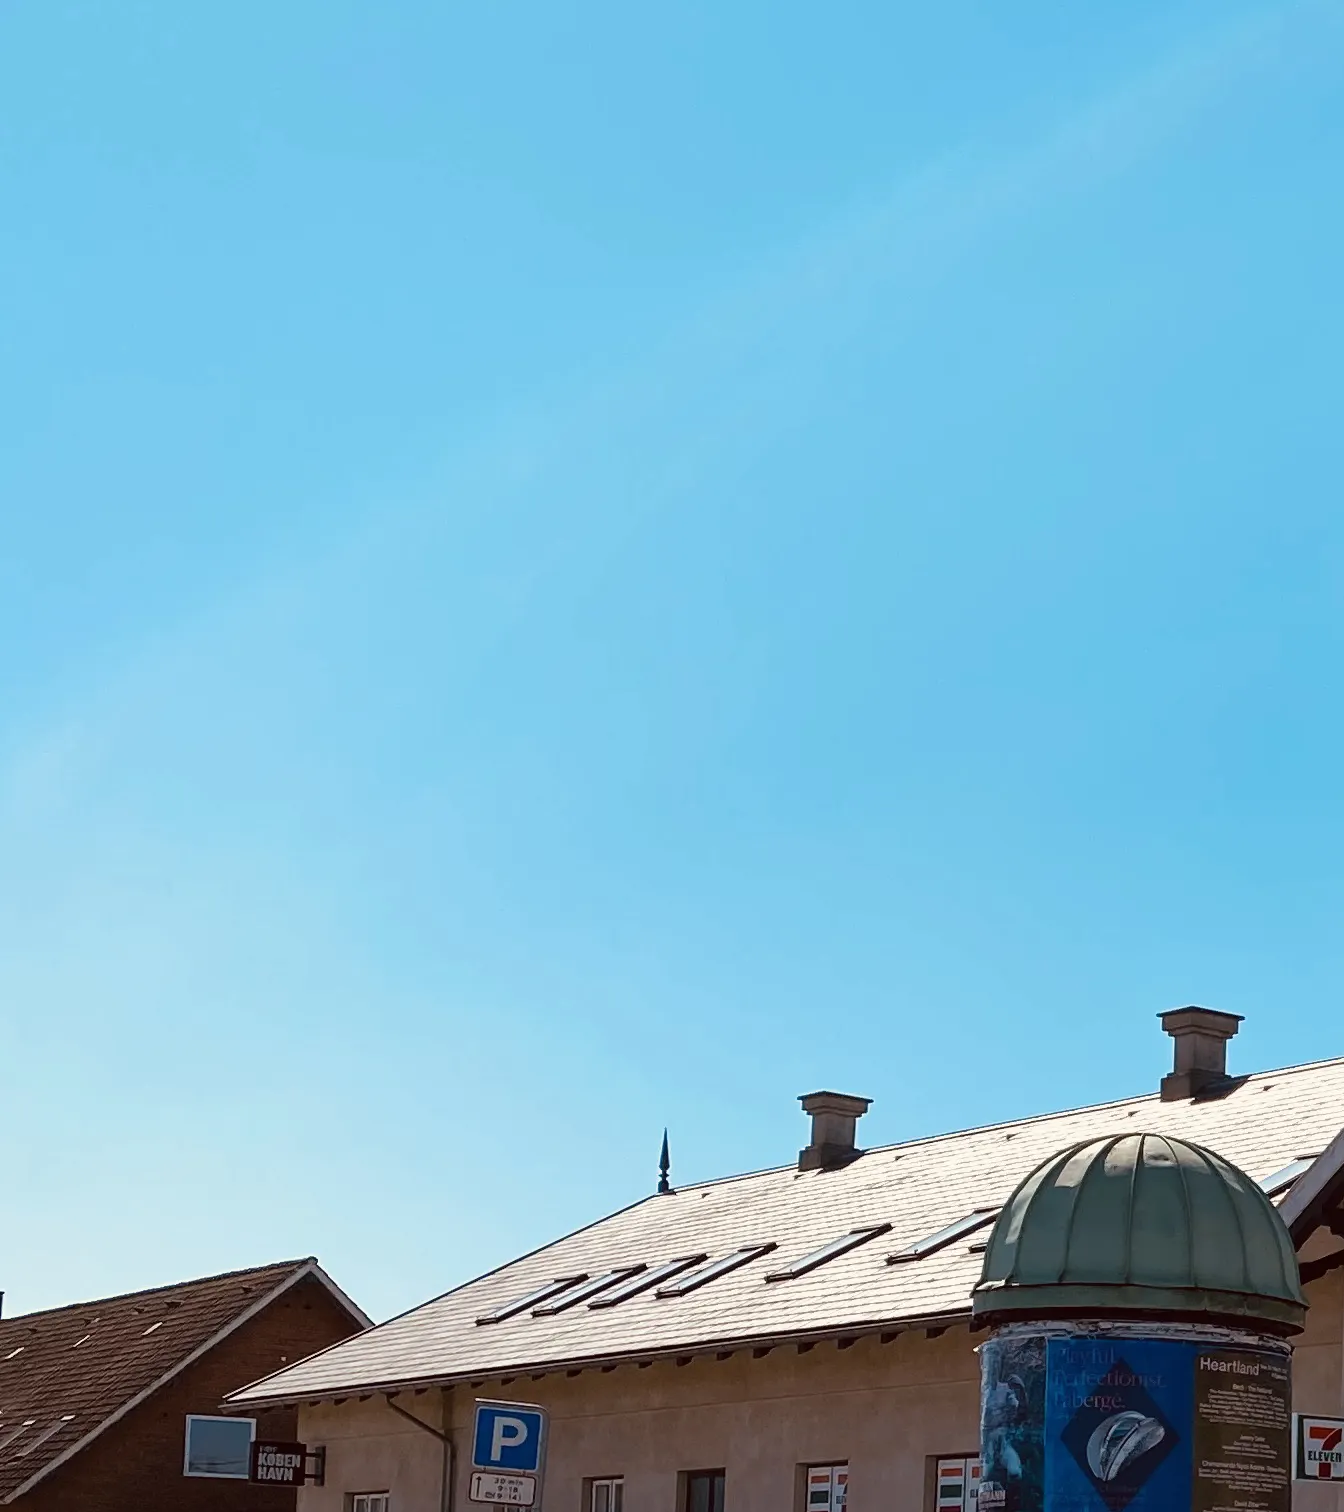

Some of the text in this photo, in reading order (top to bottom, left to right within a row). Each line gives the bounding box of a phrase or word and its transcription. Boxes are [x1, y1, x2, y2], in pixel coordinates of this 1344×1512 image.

[1200, 1357, 1260, 1376] Heartland
[490, 1416, 528, 1461] P
[1309, 1426, 1343, 1479] 7
[257, 1465, 294, 1481] HAVN
